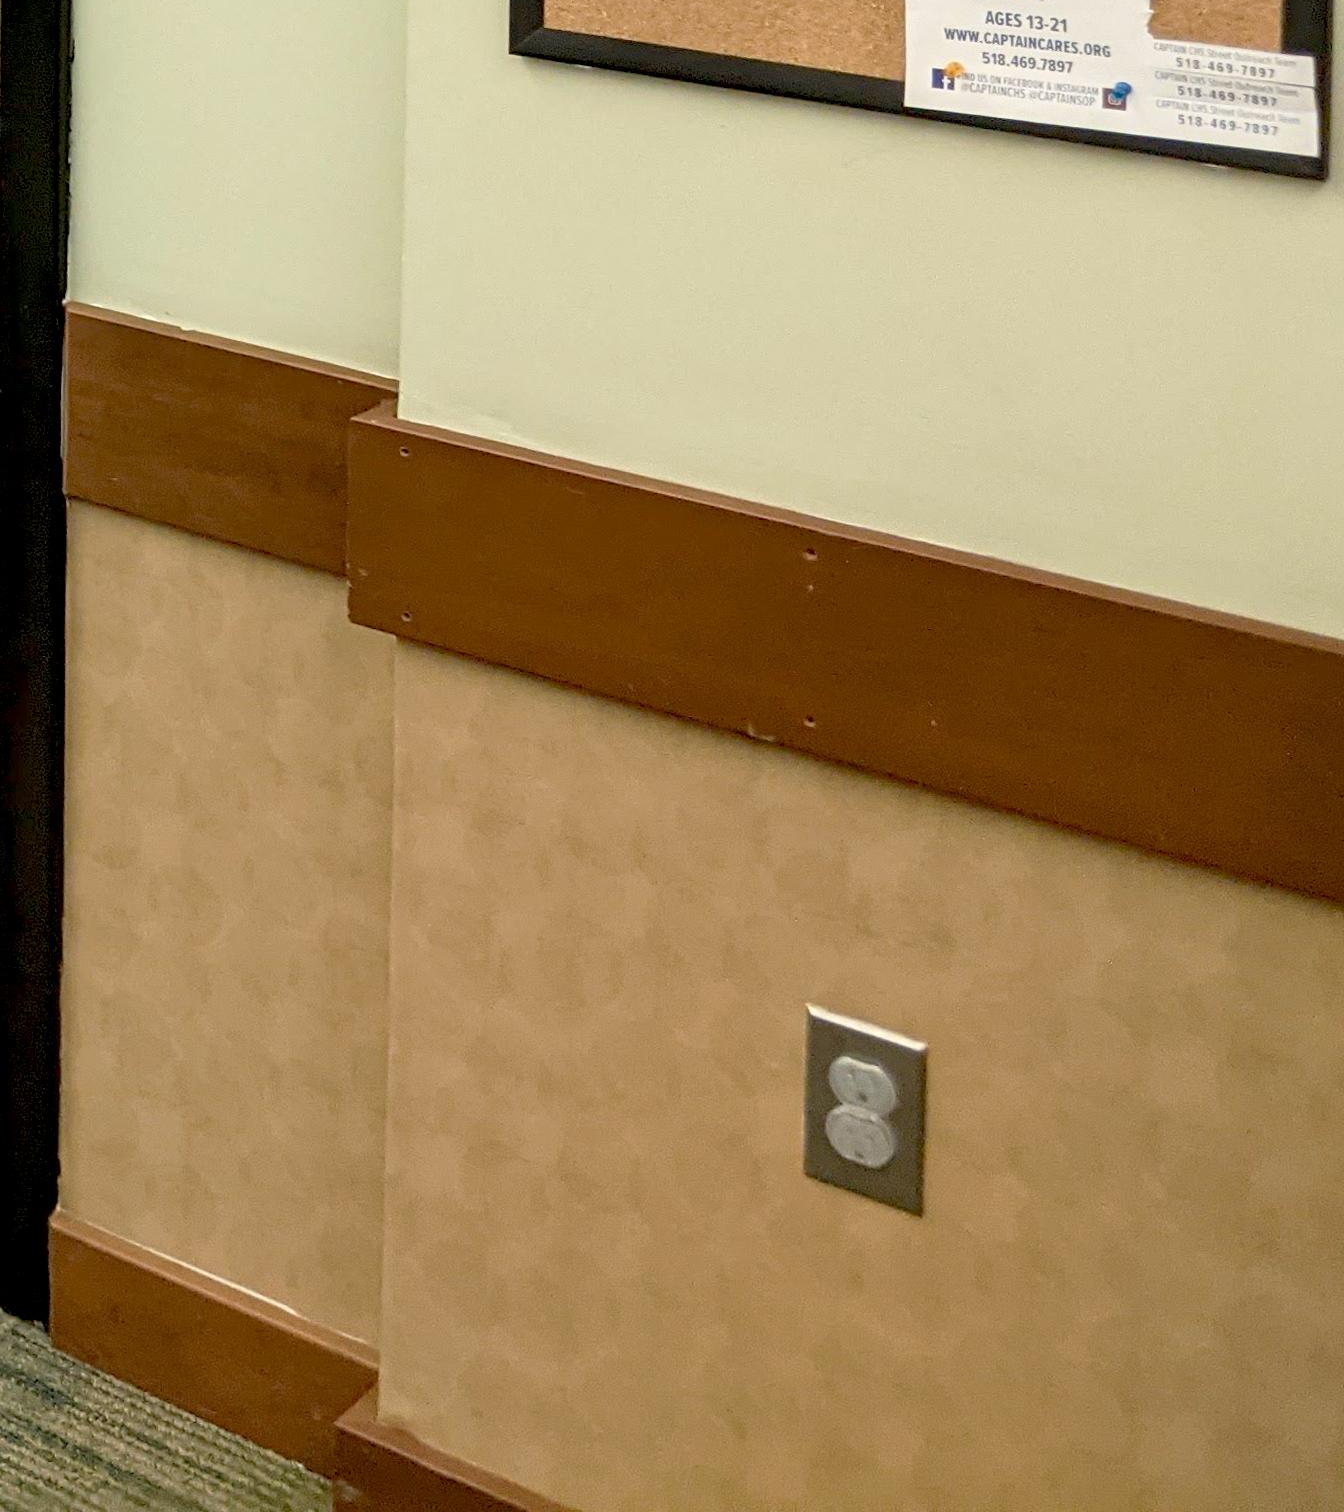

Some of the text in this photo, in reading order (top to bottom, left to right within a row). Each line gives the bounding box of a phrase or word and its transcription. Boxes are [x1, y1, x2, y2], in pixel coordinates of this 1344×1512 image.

[985, 11, 1067, 32] AGES 13-21
[944, 28, 1111, 58] WWW.CAPTAINCARES.ORG
[982, 52, 1073, 73] 518.469.7897
[1176, 57, 1275, 78] 518-469-7897
[961, 84, 1096, 106] @CAPTAINCHS @CAPTAINSOP
[978, 74, 988, 82] US
[990, 75, 1000, 84] ON
[1003, 77, 1044, 89] FACEBOOK
[1055, 83, 1099, 95] INSTAGRAM
[1178, 86, 1277, 106] 518-469-7897
[1178, 114, 1278, 135] 518-469-7897
